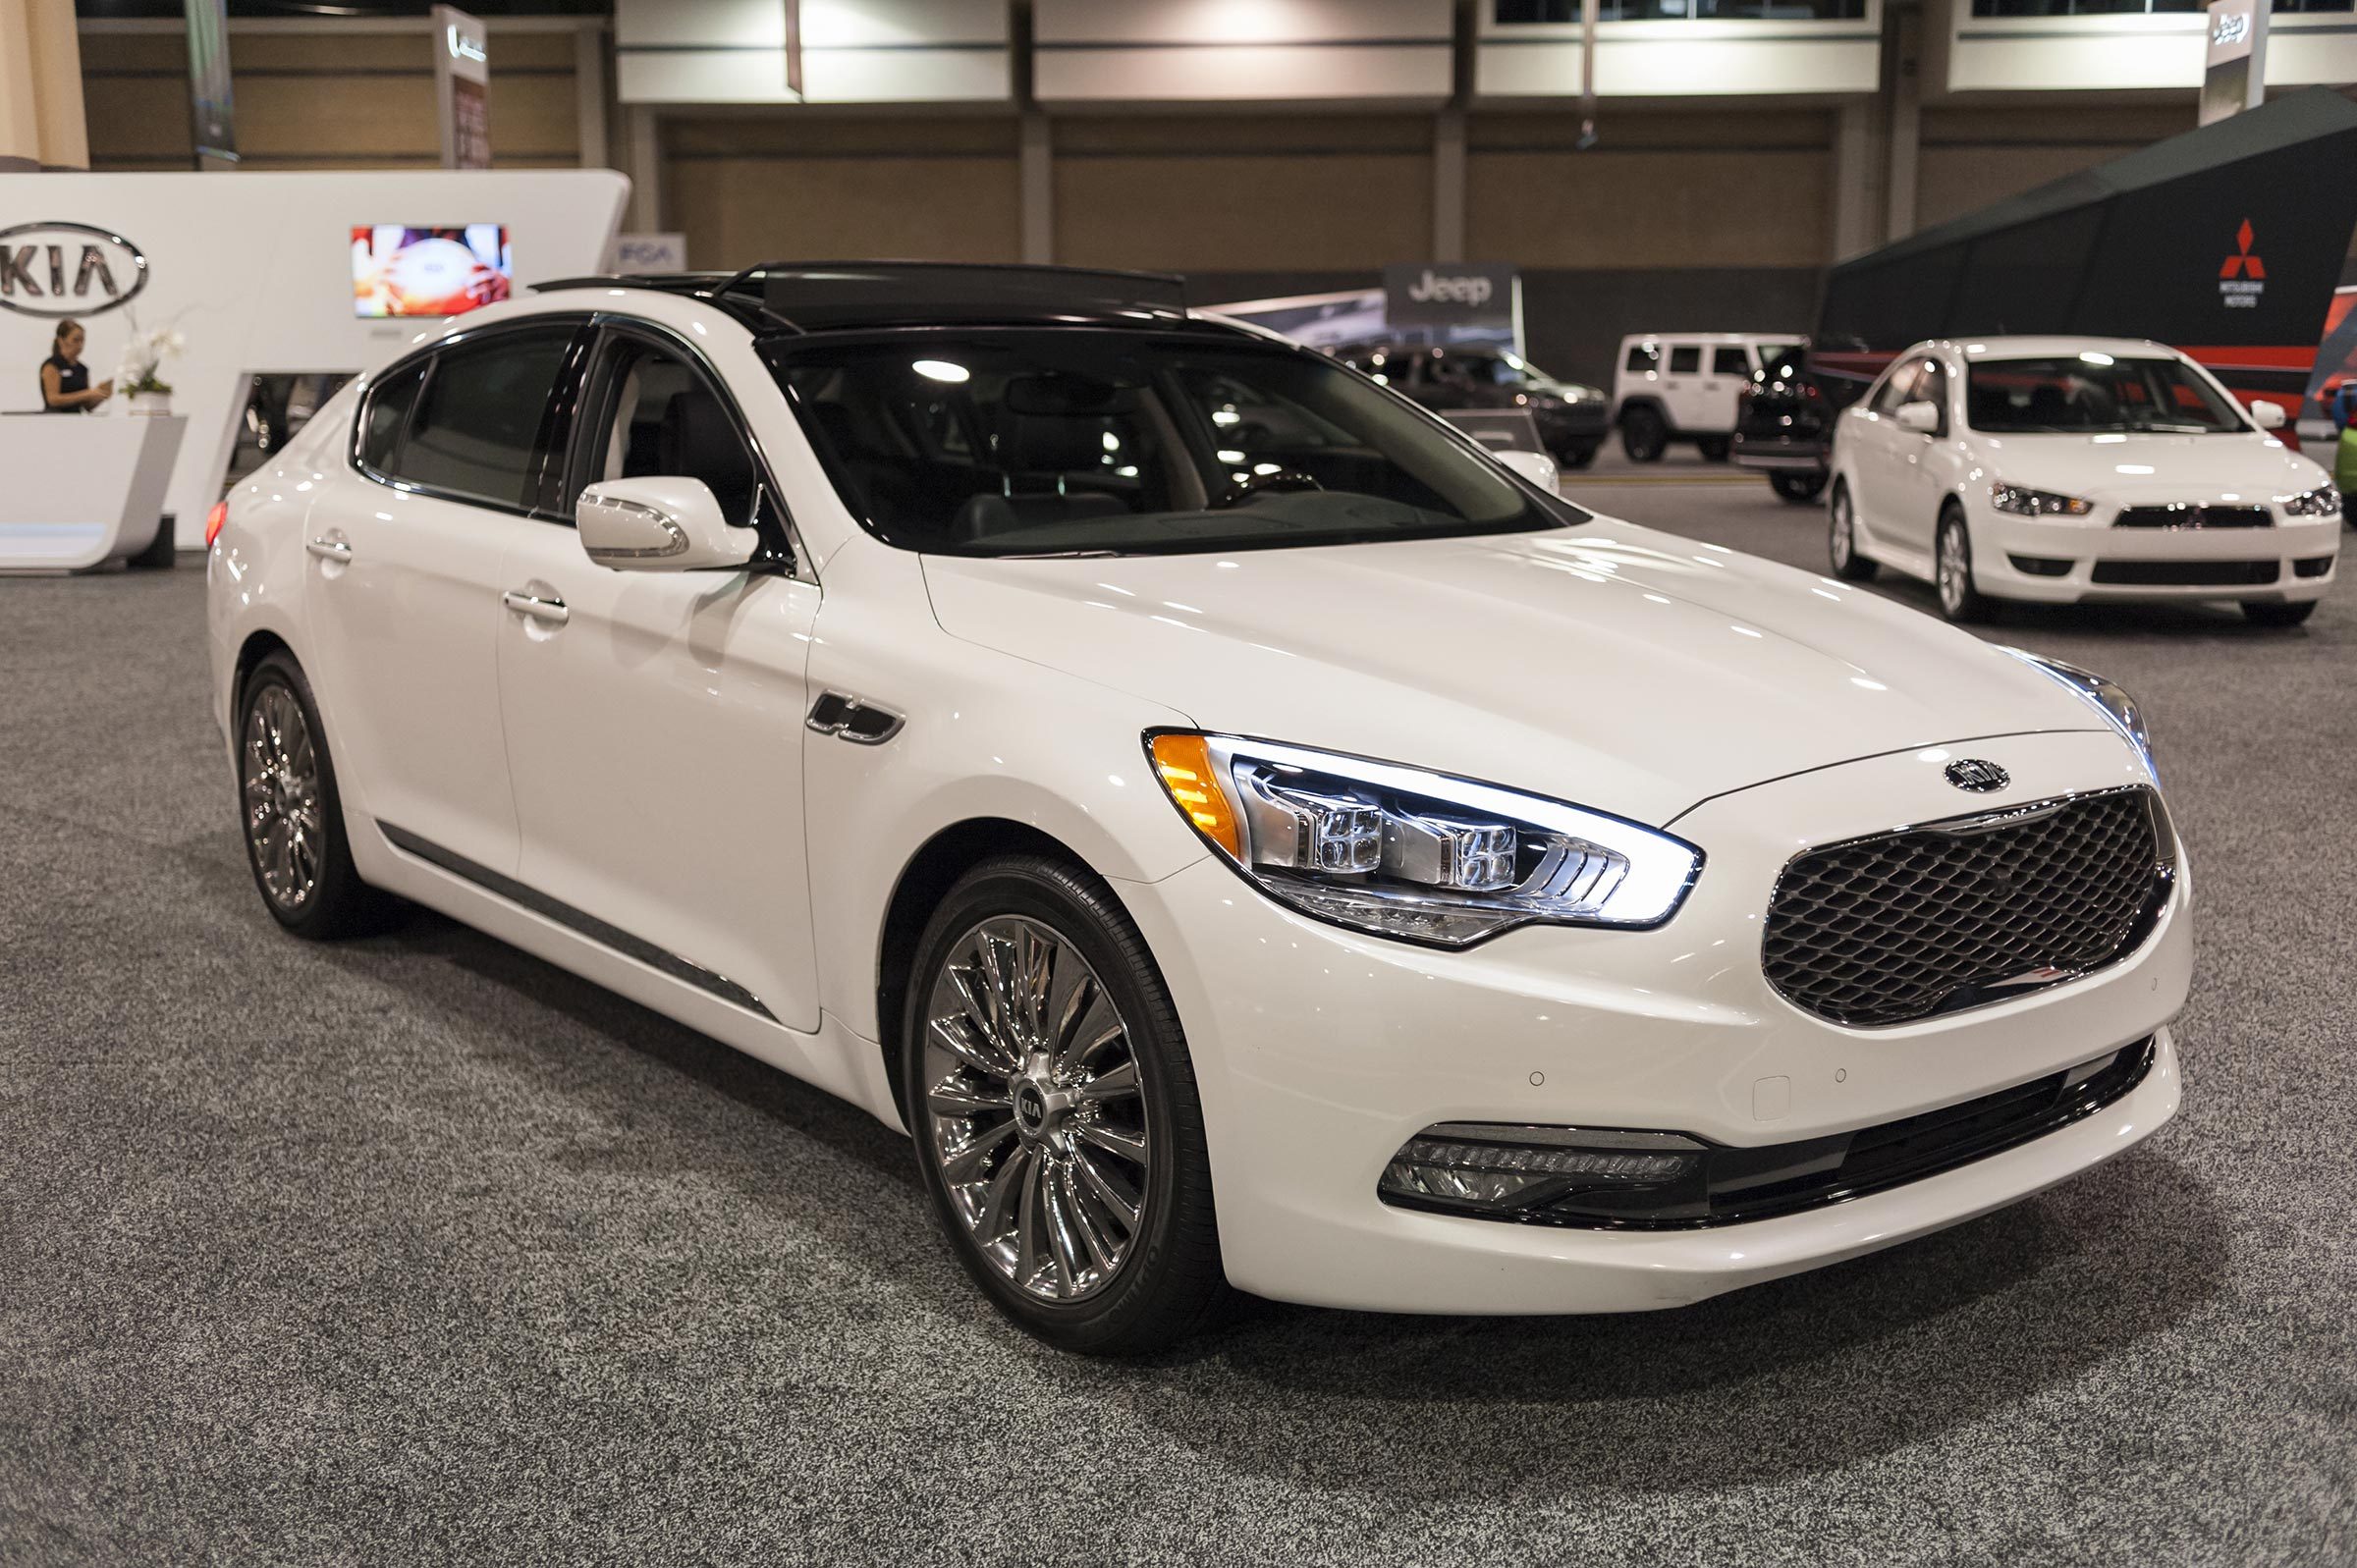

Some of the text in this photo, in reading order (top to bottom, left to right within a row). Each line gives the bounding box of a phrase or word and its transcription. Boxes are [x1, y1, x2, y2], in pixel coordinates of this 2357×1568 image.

[0, 243, 119, 297] KIA
[1408, 269, 1492, 306] Jeep
[1951, 762, 2007, 784] KIA
[1021, 1097, 1041, 1118] KIA
